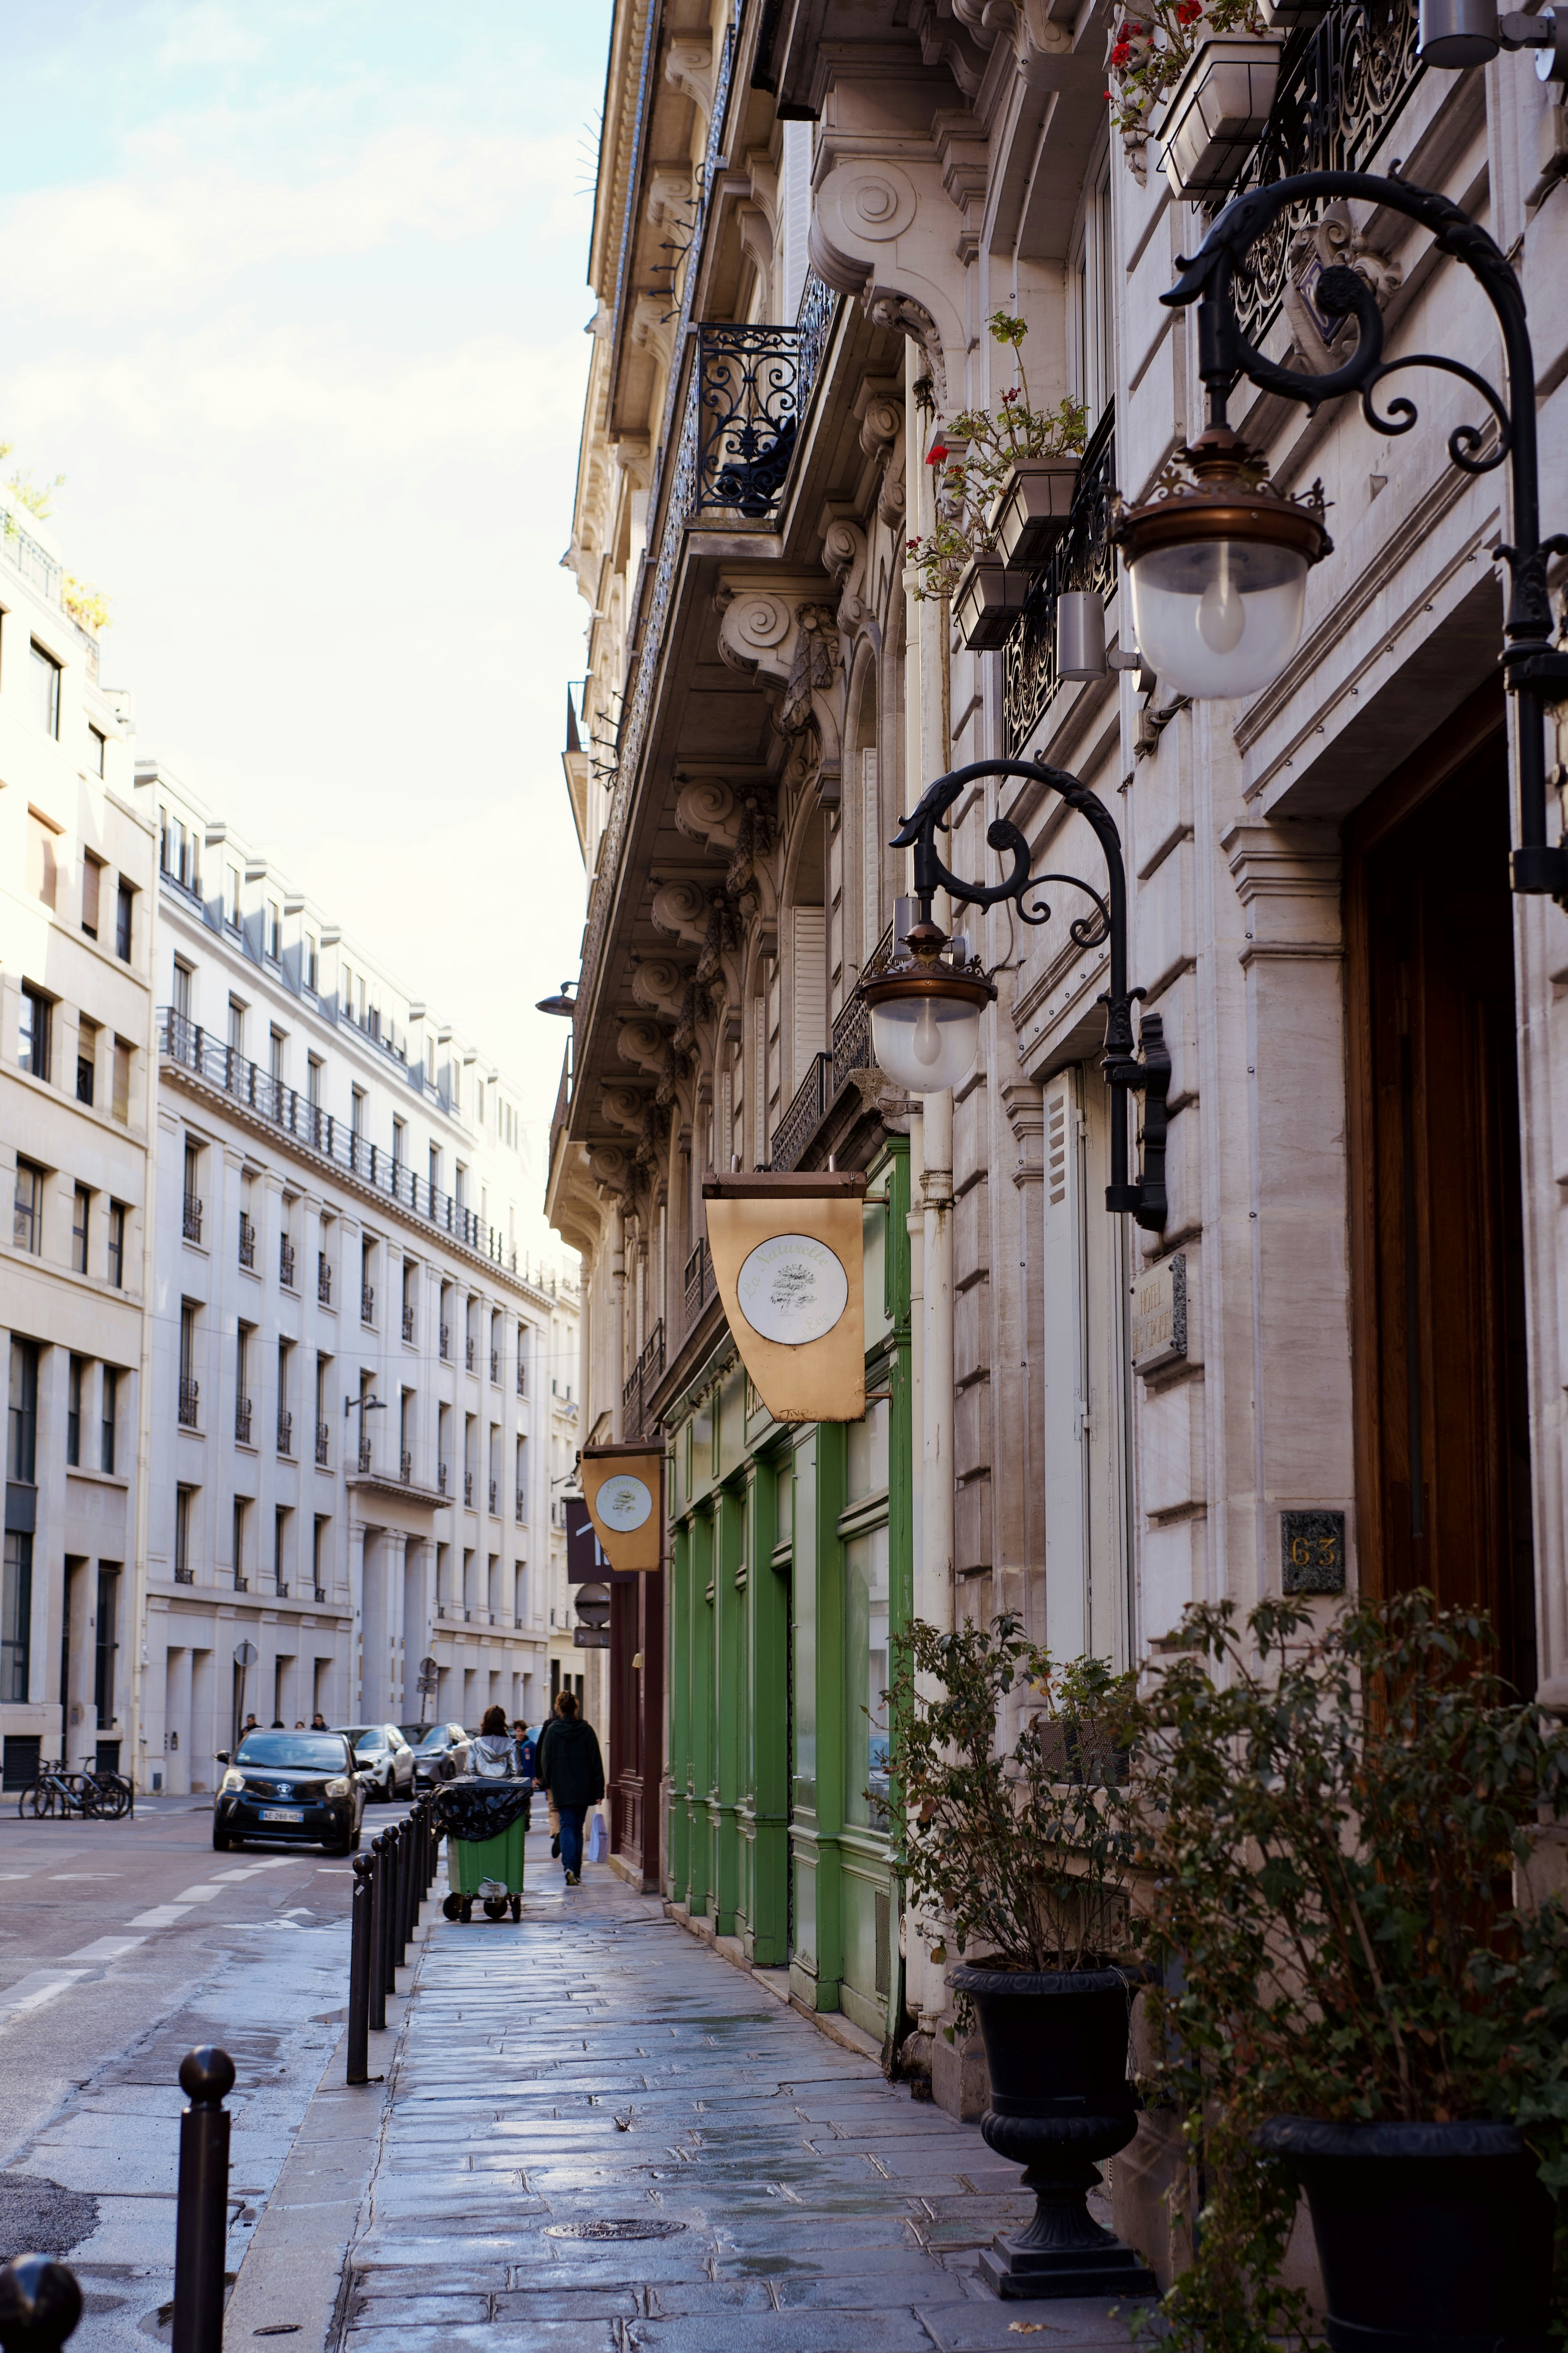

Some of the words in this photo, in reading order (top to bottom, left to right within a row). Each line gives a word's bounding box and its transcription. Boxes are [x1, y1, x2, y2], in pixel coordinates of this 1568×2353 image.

[742, 1276, 761, 1300] La
[756, 1243, 828, 1272] Naturelle
[1140, 1281, 1163, 1316] HOTEL
[802, 1312, 830, 1339] d'Eve
[1132, 1327, 1143, 1356] DES
[606, 1479, 643, 1494] Naturelle
[1291, 1537, 1337, 1565] 63
